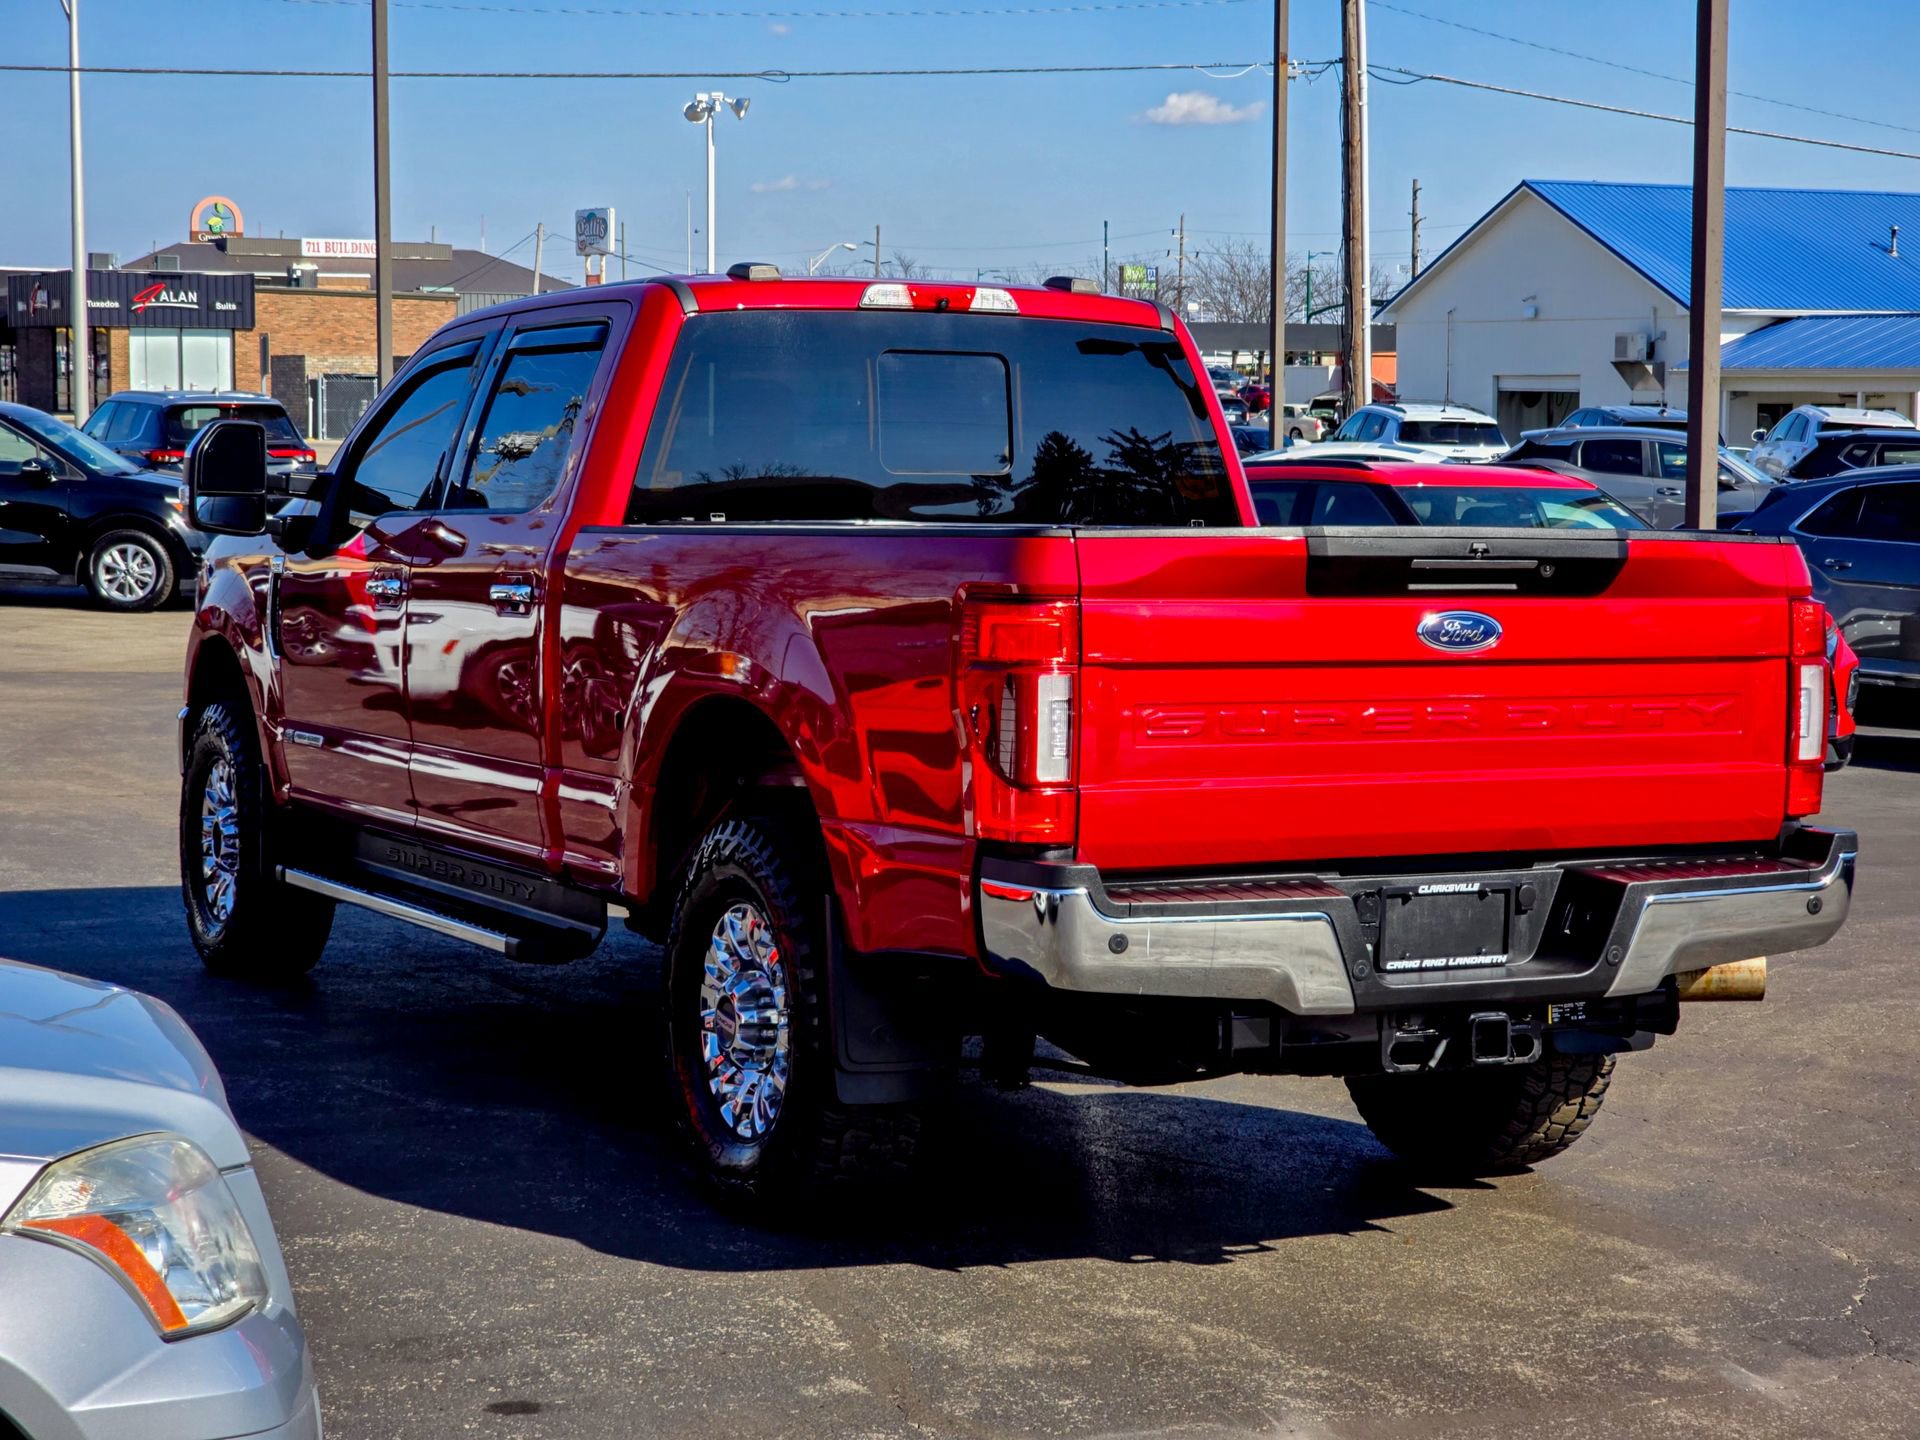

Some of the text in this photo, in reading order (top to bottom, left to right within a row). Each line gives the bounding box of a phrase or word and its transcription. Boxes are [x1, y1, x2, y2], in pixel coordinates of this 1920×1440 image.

[306, 241, 320, 253] 711
[159, 290, 198, 303] ALAN
[86, 299, 120, 308] Tuxedos
[215, 302, 237, 310] Suits
[1439, 619, 1484, 642] Ford
[1145, 698, 1736, 738] SUPER DUTY
[386, 847, 536, 900] SUPER DUTY
[1418, 883, 1480, 894] CLARKSVILLE
[1421, 957, 1446, 968] AND
